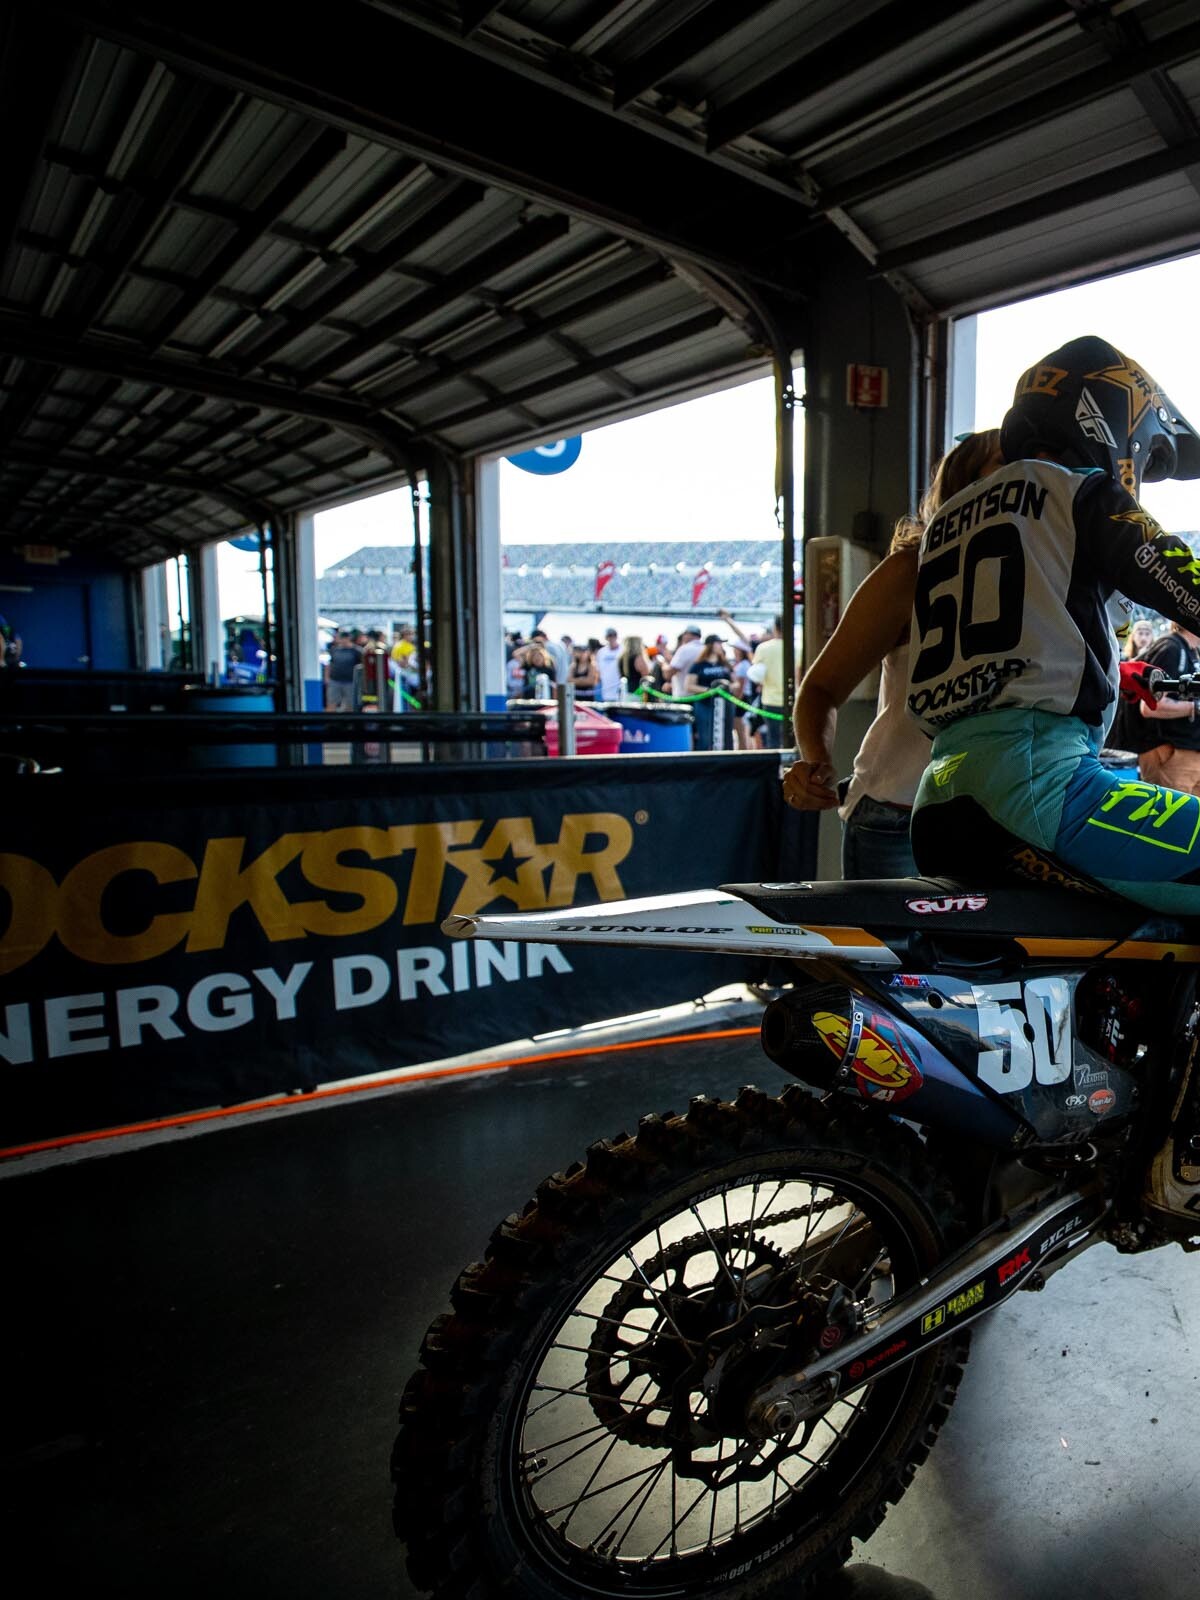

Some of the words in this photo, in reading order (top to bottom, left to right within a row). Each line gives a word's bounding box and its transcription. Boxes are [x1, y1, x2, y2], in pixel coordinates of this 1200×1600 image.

[910, 522, 1026, 684] 50
[1100, 783, 1191, 829] FLY
[908, 897, 988, 914] GUTS
[555, 925, 735, 934] DUNLOP
[751, 926, 803, 936] PROTAPER
[332, 940, 574, 1012] DRINK
[970, 977, 1072, 1095] 50
[1039, 1216, 1083, 1254] EXCEL
[996, 1248, 1032, 1284] RK
[865, 1338, 909, 1369] brembo
